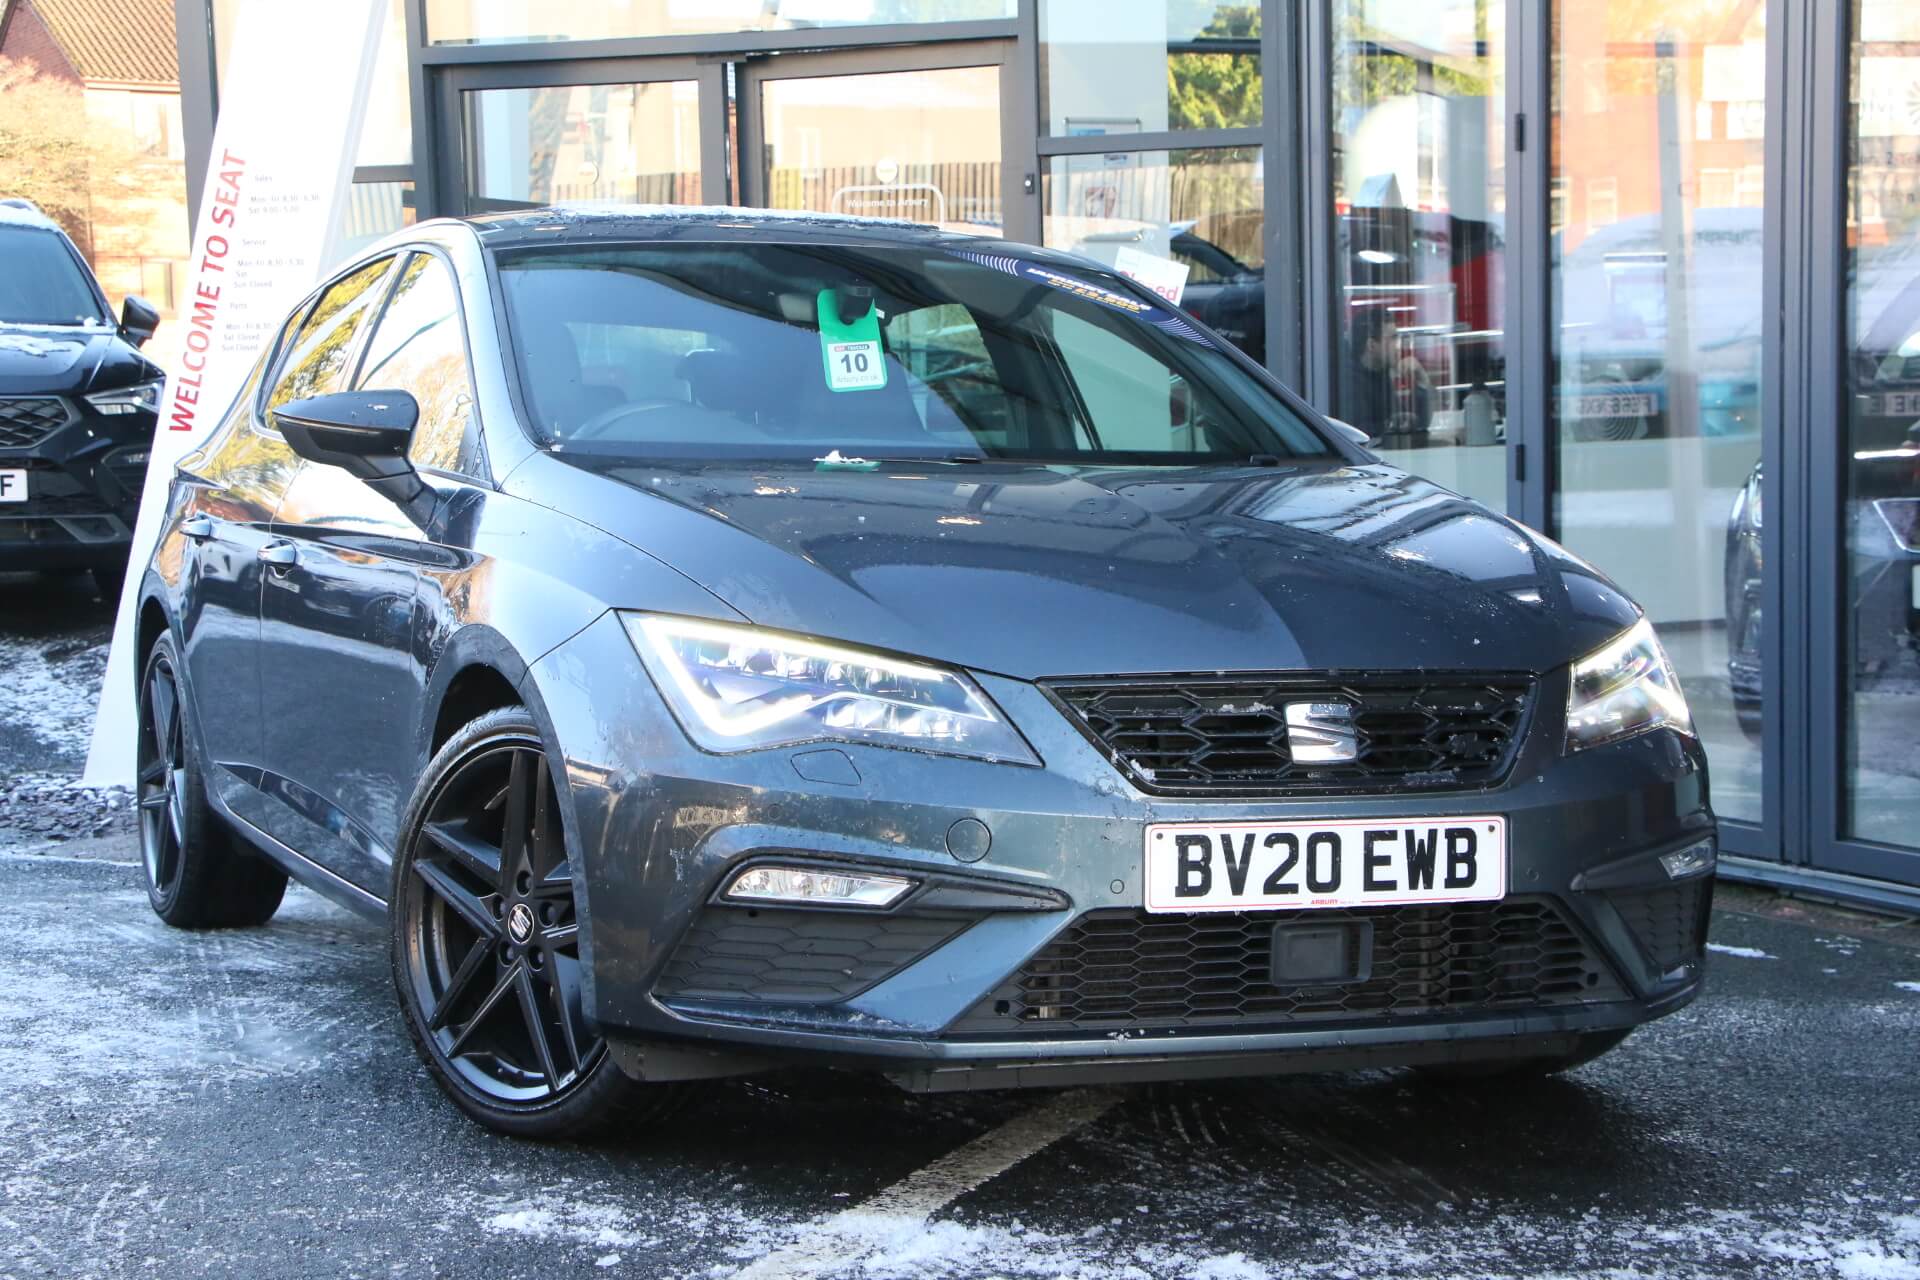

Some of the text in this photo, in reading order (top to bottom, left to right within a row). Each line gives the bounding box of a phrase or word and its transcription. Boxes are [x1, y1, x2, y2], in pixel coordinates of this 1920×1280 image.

[846, 199, 885, 208] Welcome
[168, 148, 246, 432] WELCOME TO SEAT
[841, 353, 869, 374] 10
[1175, 827, 1478, 898] BV20 EWB
